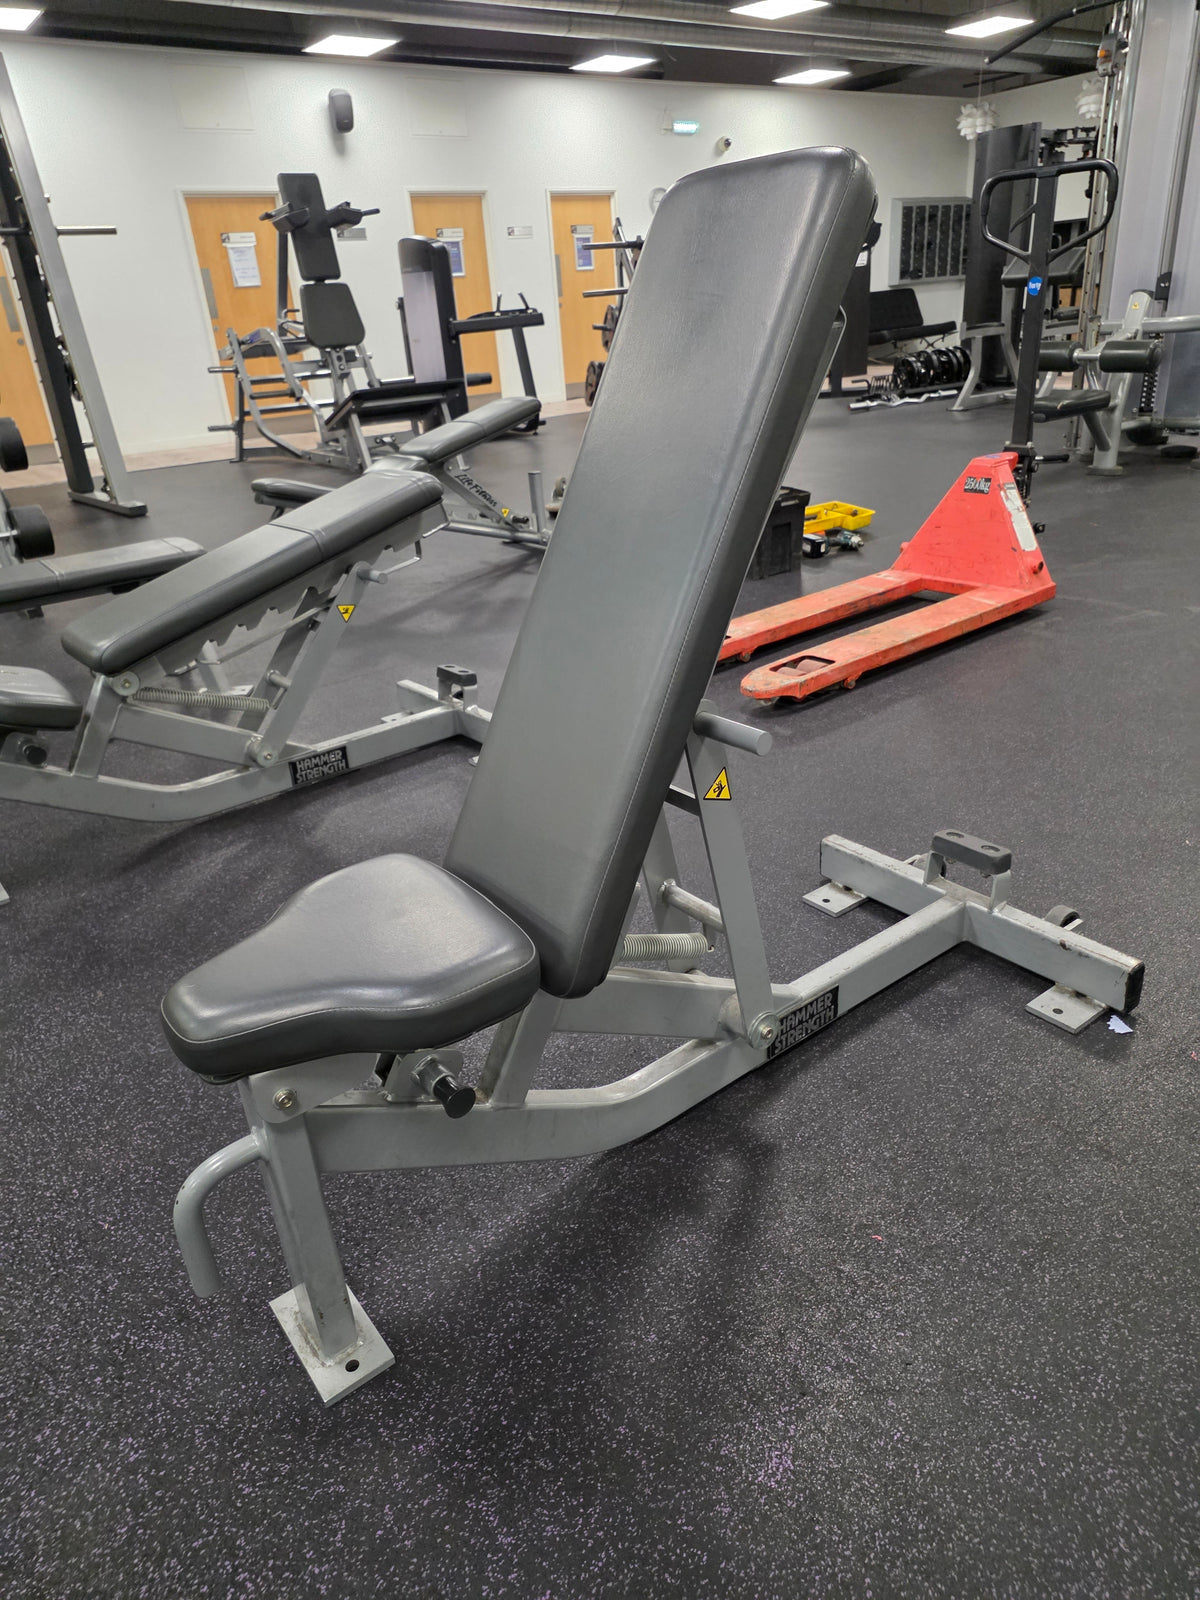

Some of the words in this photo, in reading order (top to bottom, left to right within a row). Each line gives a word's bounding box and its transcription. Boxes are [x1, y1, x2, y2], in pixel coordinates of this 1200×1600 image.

[296, 750, 342, 771] HAMMER
[296, 759, 346, 784] STRENGTH
[774, 1005, 835, 1054] STRENGTH
[779, 992, 833, 1034] HAMMER
